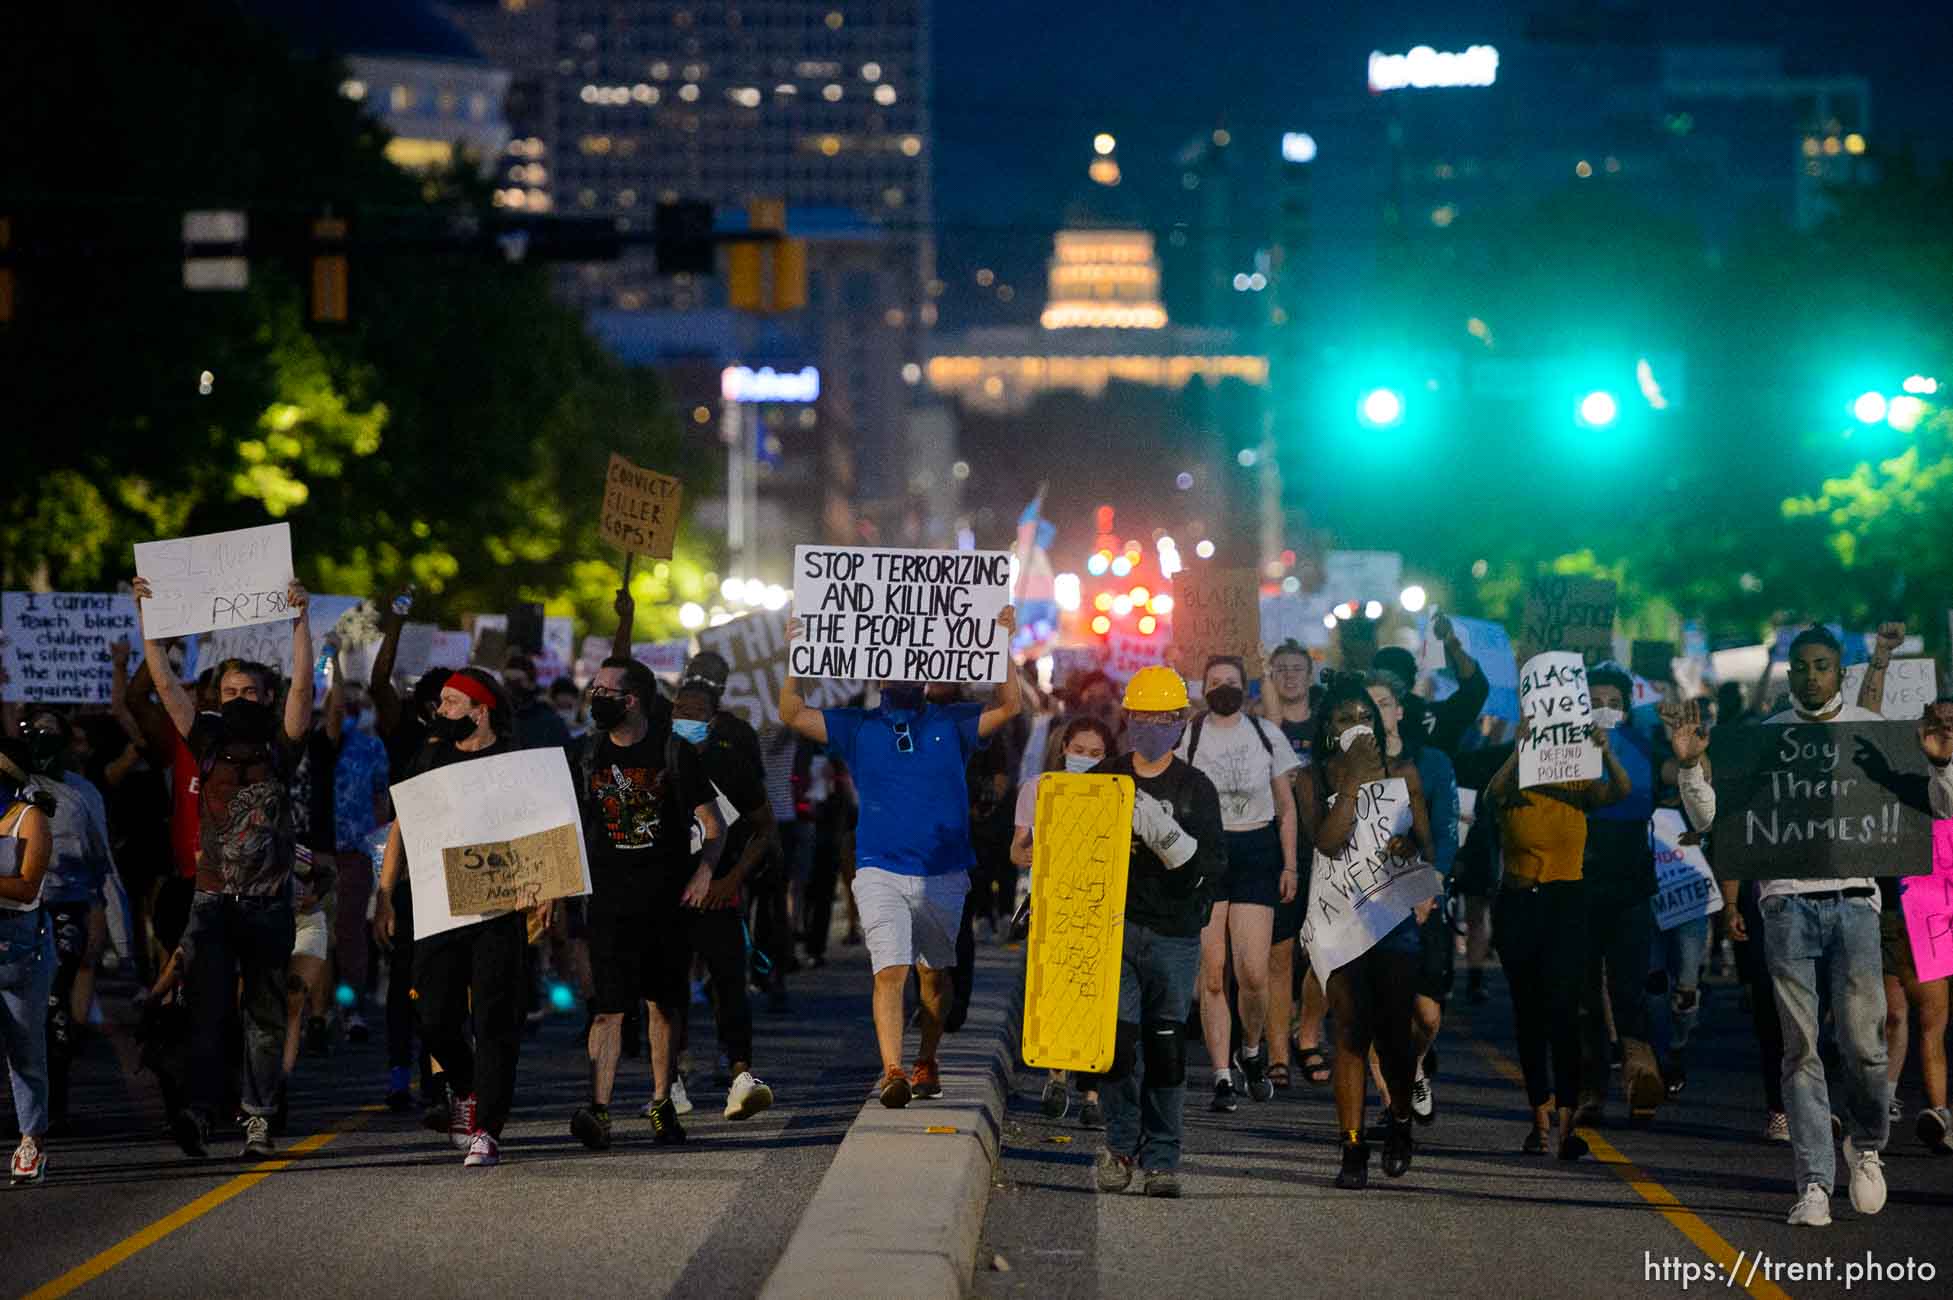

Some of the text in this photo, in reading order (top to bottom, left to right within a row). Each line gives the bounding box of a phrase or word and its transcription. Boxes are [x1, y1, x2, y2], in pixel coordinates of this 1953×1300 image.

[605, 516, 654, 549] COPS!
[804, 552, 1009, 587] STOP TERRORIZING
[25, 593, 40, 611] I
[820, 582, 973, 617] AND KILLING
[801, 614, 997, 649] THE PEOPLE YOU
[792, 646, 1000, 681] CLAIM TO PROTECT
[1521, 664, 1586, 697] BLACK
[1537, 765, 1582, 783] POLICE
